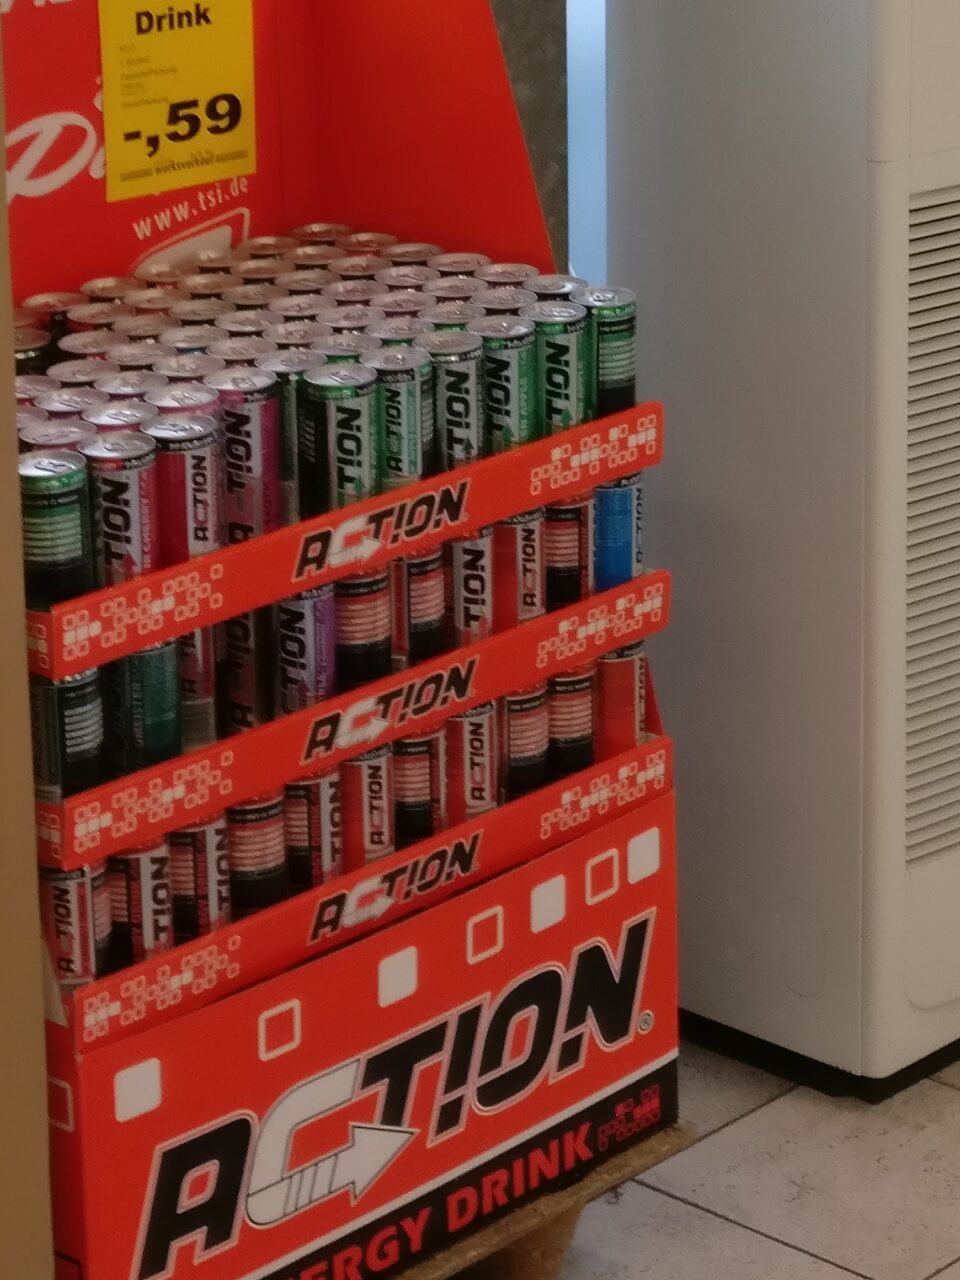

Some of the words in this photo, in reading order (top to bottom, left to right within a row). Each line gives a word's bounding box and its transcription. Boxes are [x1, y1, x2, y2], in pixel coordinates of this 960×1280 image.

[135, 3, 212, 35] Drink
[123, 93, 242, 157] -,59
[132, 175, 249, 240] www.tsi.de
[445, 369, 470, 448] TION
[485, 355, 511, 433] TION
[546, 340, 570, 420] TION
[336, 405, 362, 496] TION
[101, 477, 131, 566] TION
[447, 1122, 594, 1234] DRINK
